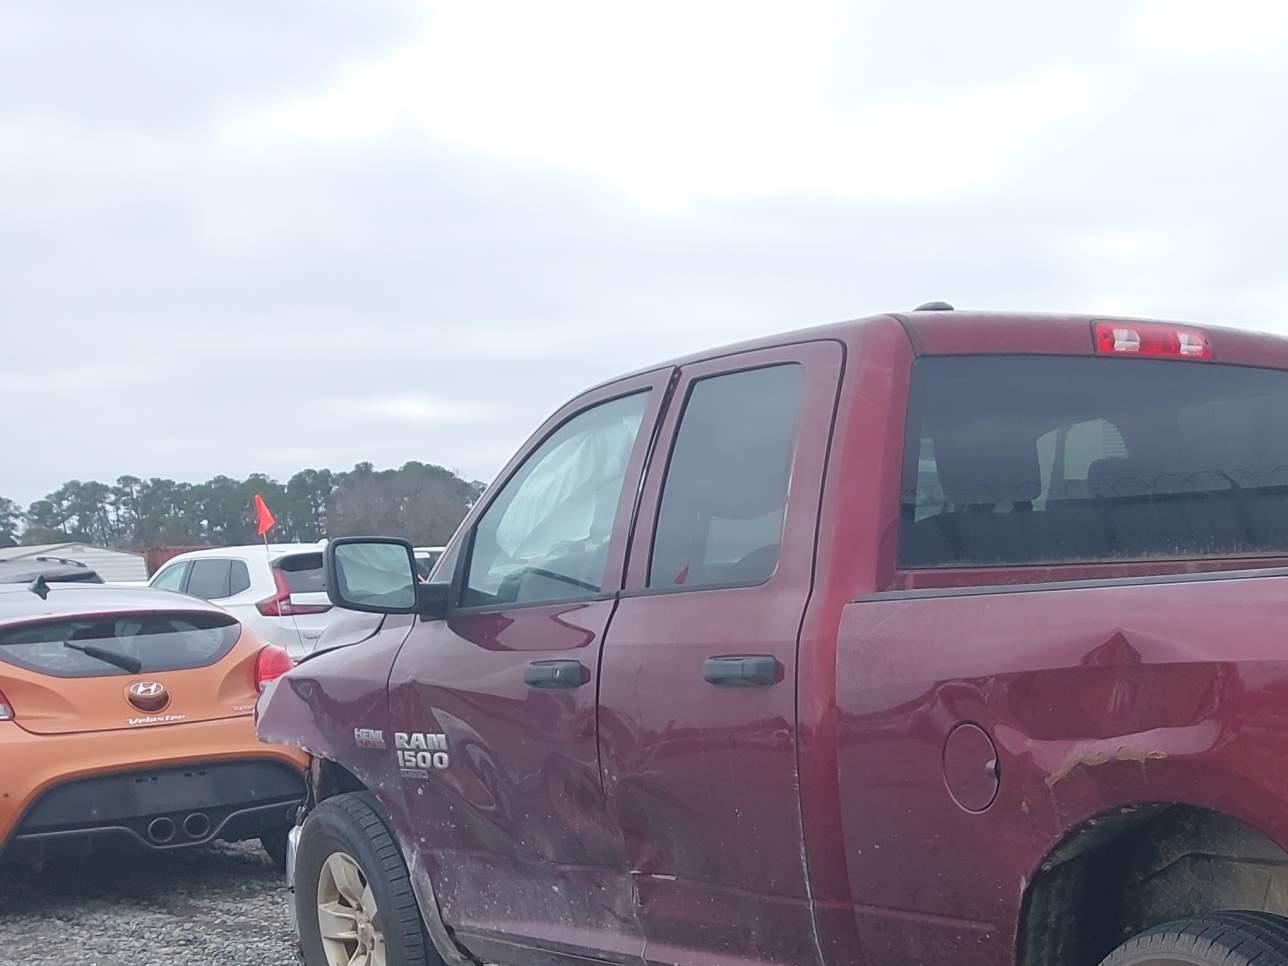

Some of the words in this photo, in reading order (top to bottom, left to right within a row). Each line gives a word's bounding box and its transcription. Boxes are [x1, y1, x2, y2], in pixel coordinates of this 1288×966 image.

[354, 728, 384, 740] HEMI
[394, 732, 448, 750] RAM
[396, 750, 449, 769] 1500
